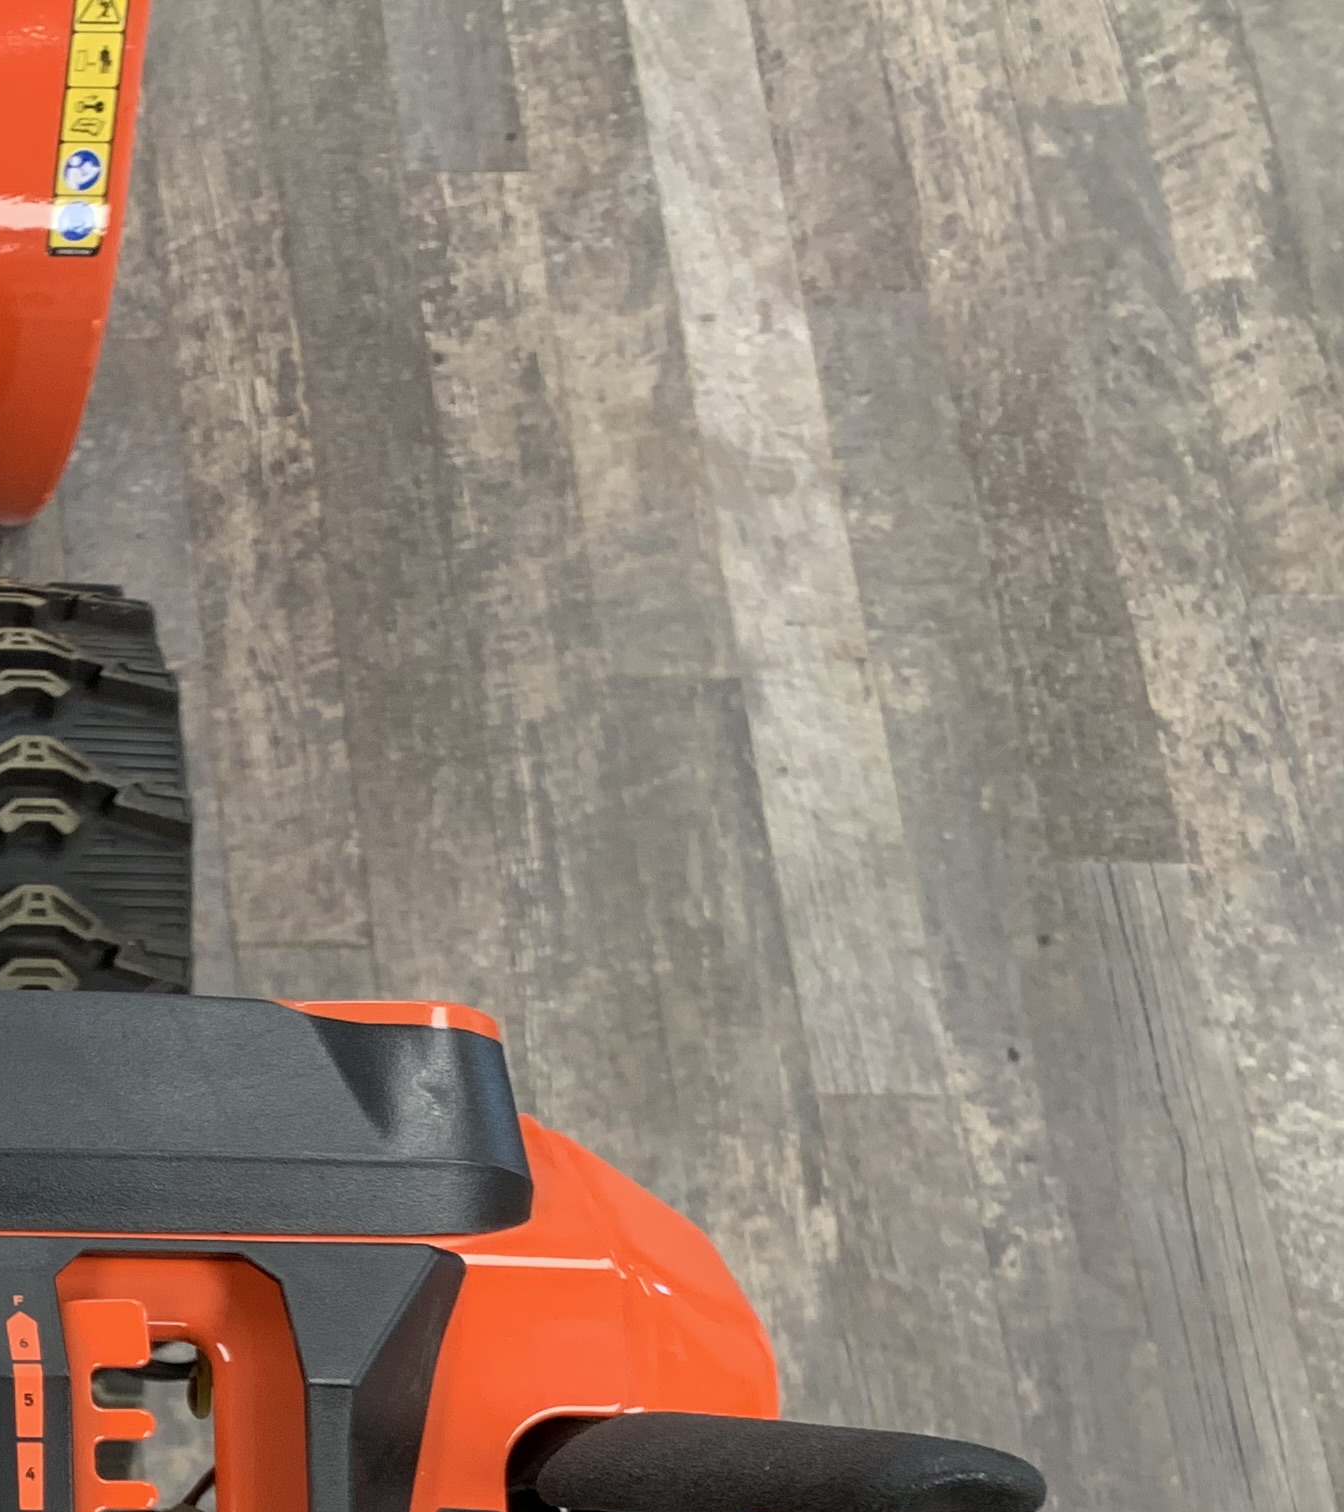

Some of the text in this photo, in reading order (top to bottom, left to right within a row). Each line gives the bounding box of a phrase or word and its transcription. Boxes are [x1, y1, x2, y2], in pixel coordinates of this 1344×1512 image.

[12, 1295, 24, 1307] F
[19, 1337, 30, 1349] 6
[23, 1393, 34, 1407] 5
[25, 1467, 35, 1481] 4
